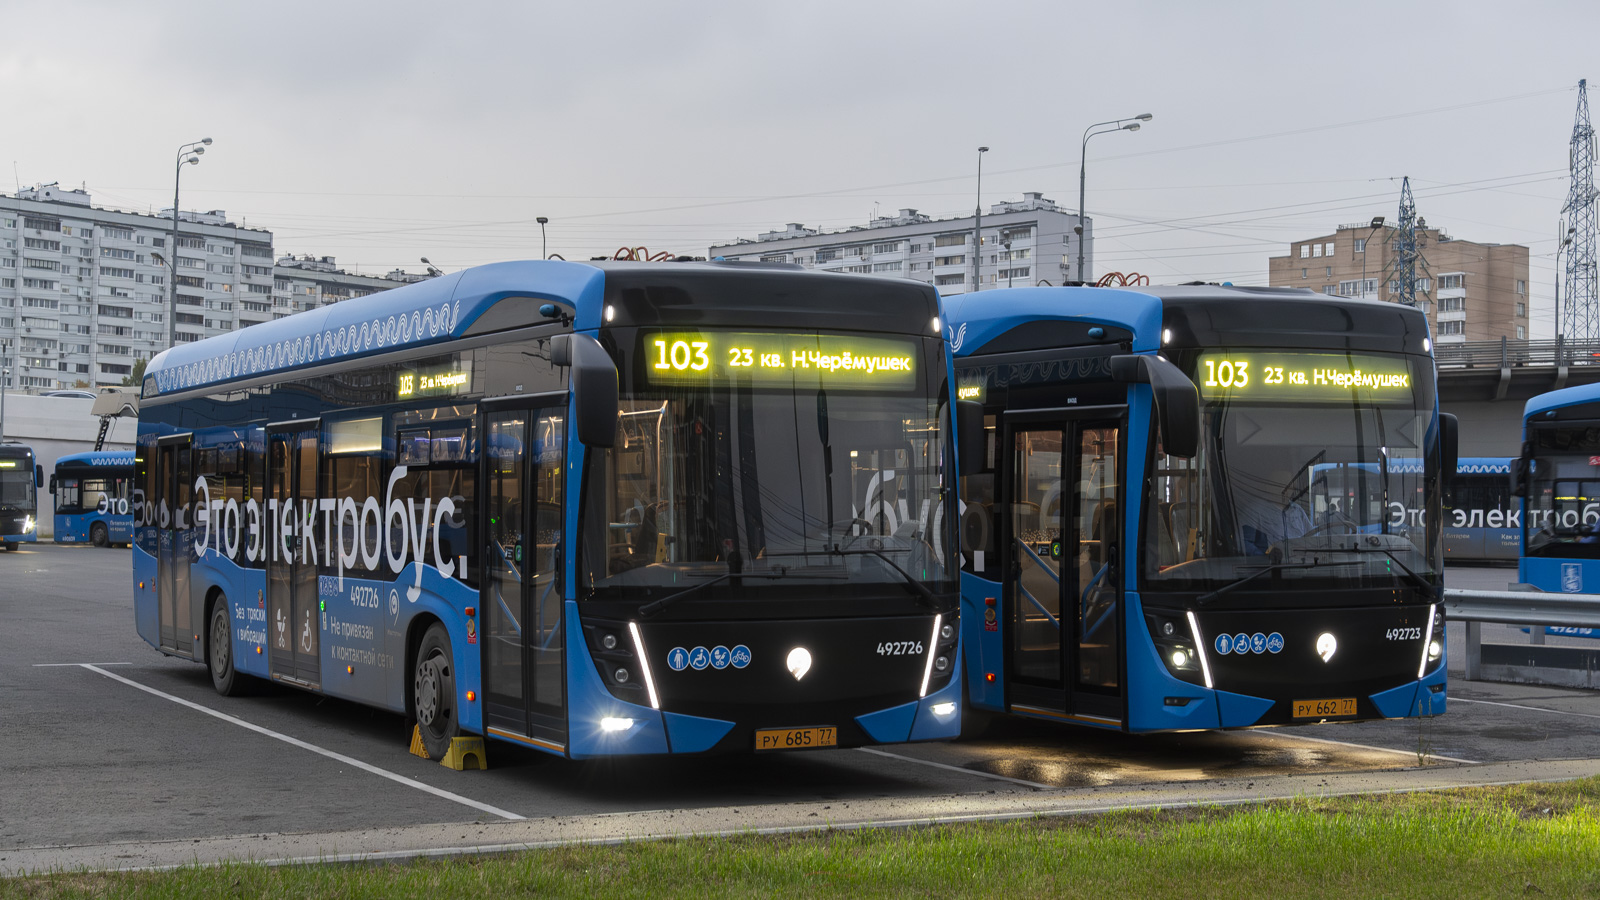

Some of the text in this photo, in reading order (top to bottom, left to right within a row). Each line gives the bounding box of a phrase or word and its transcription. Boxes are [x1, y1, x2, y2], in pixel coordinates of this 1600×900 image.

[654, 340, 911, 374] 103 23 кв. Н.Черёмушек
[399, 375, 414, 395] 103
[420, 376, 428, 389] 23
[1205, 360, 1409, 390] 103 23 кв. Н.Черёмушек
[97, 491, 129, 515] Это
[195, 466, 468, 603] Это электробус.
[350, 585, 379, 609] 492726
[246, 607, 266, 624] тряски
[240, 625, 267, 646] вибраций
[330, 616, 374, 641] Не привязан
[1385, 627, 1421, 641] 492723
[336, 646, 376, 666] контактной
[377, 653, 394, 669] сети
[876, 641, 923, 656] 492726
[1298, 705, 1311, 716] РУ
[1316, 701, 1337, 715] 662
[1343, 699, 1353, 710] 77
[762, 728, 832, 748] РУ 685 77
